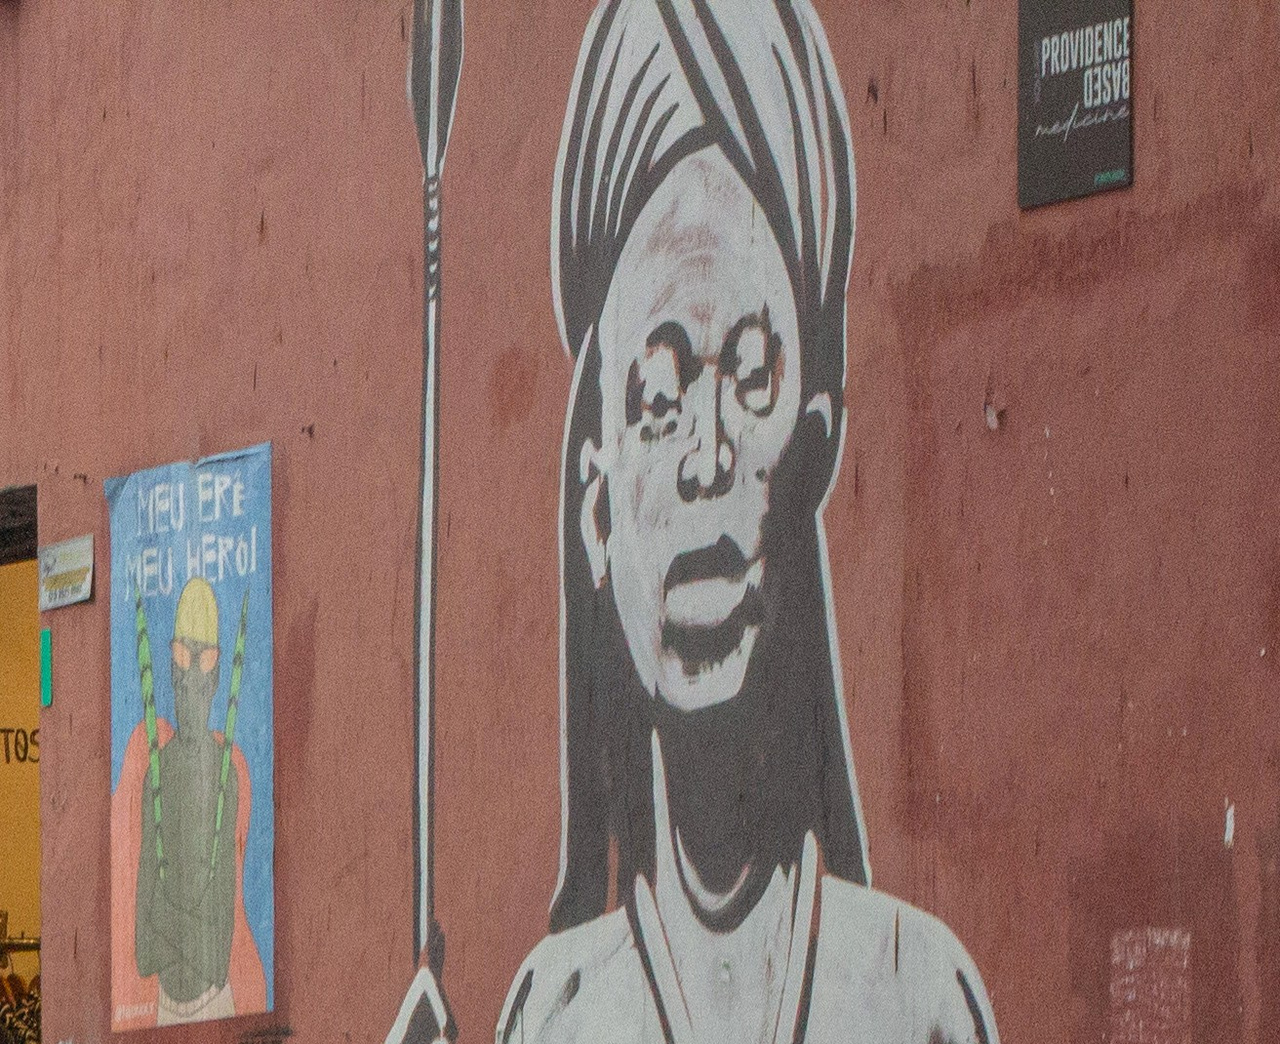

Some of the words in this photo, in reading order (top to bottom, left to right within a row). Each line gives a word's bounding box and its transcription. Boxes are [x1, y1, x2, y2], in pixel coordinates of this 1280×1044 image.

[1041, 17, 1129, 79] PROVIDENCE
[1084, 58, 1129, 109] BASED
[137, 482, 185, 536] MEU
[124, 546, 173, 600] MEU
